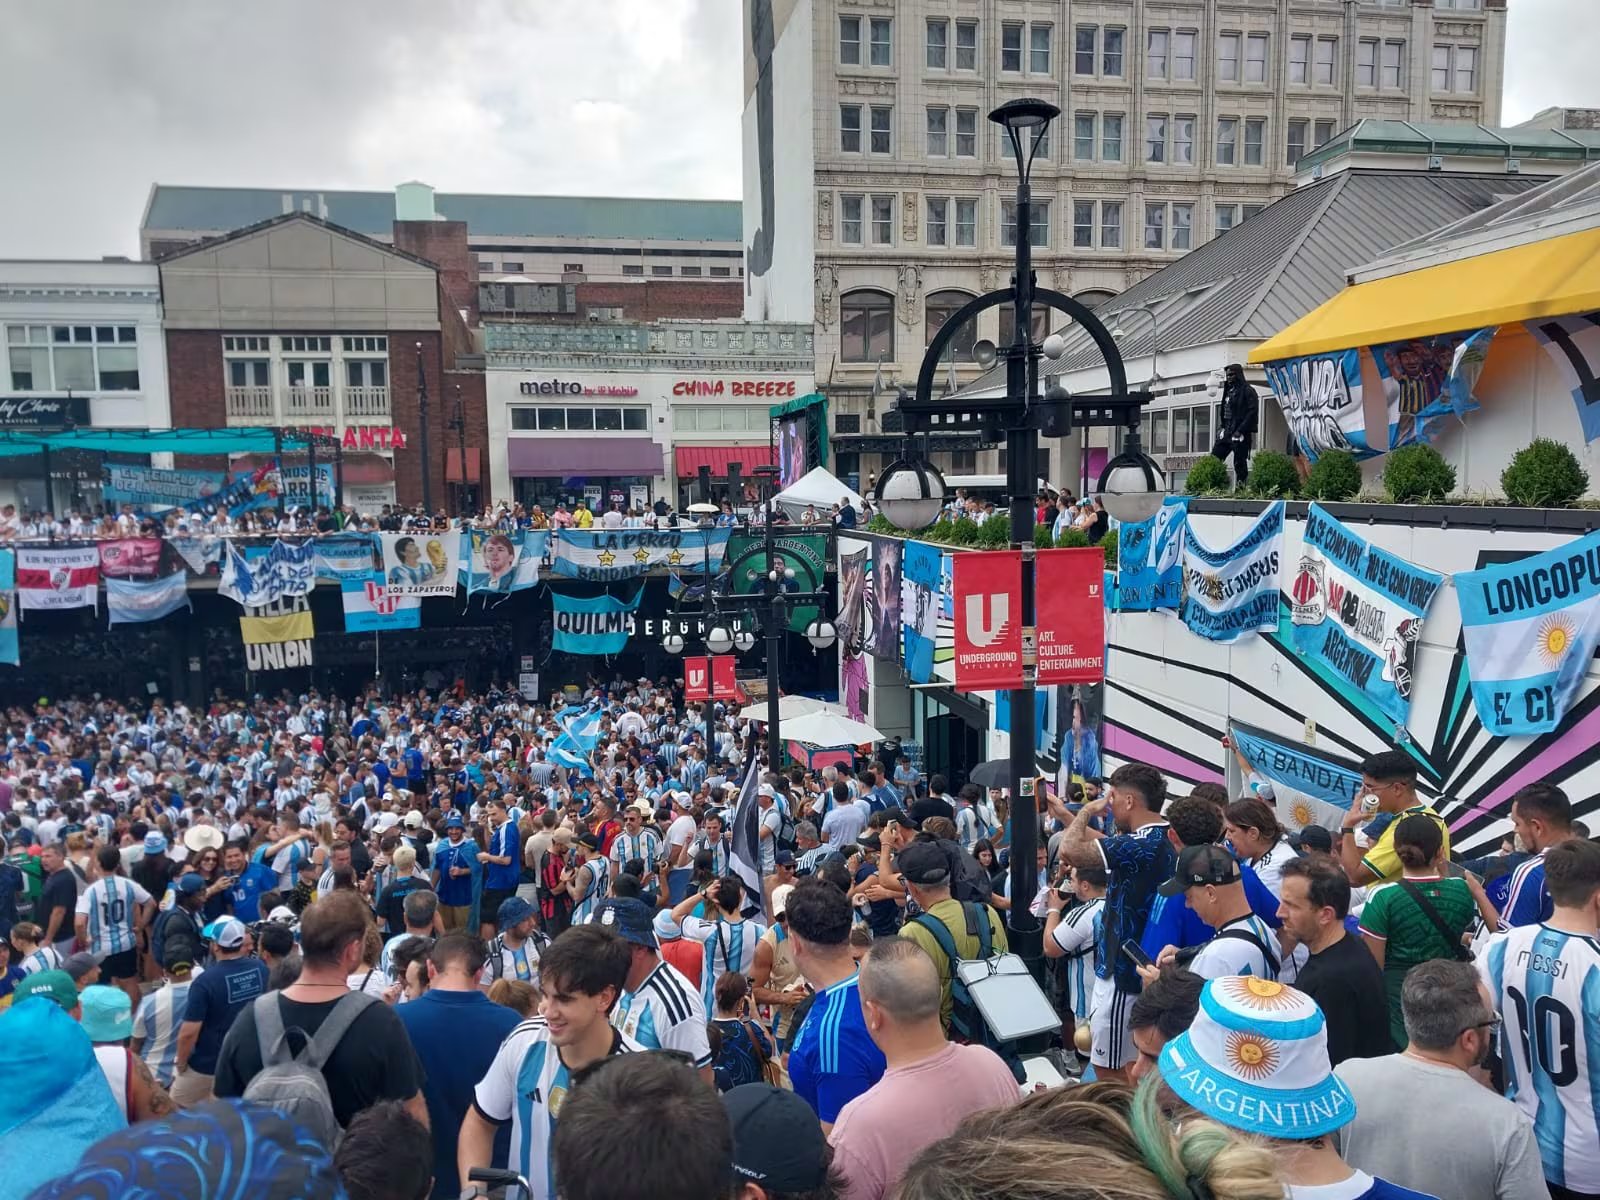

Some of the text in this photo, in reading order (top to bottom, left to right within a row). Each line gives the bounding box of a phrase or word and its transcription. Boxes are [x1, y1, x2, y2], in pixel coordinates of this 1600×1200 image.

[519, 379, 582, 394] metro
[673, 380, 796, 397] CHINA BREEZE
[388, 585, 455, 594] LOS ZAPATEROS
[1039, 631, 1056, 642] ART.
[245, 639, 313, 672] UNION
[959, 651, 1018, 665] UNDERGROUND
[1039, 645, 1075, 656] CULTURE.
[1321, 626, 1376, 691] ARGENTINA
[1039, 656, 1103, 671] ENTERTAINMENT.
[1493, 691, 1513, 726] EL
[1246, 743, 1268, 767] LA
[1273, 751, 1347, 798] BANDA
[101, 899, 125, 926] 10
[1516, 950, 1569, 980] MESSI
[31, 984, 53, 994] BOSS
[1506, 985, 1579, 1088] 10
[1180, 1068, 1349, 1128] ARGENTINA
